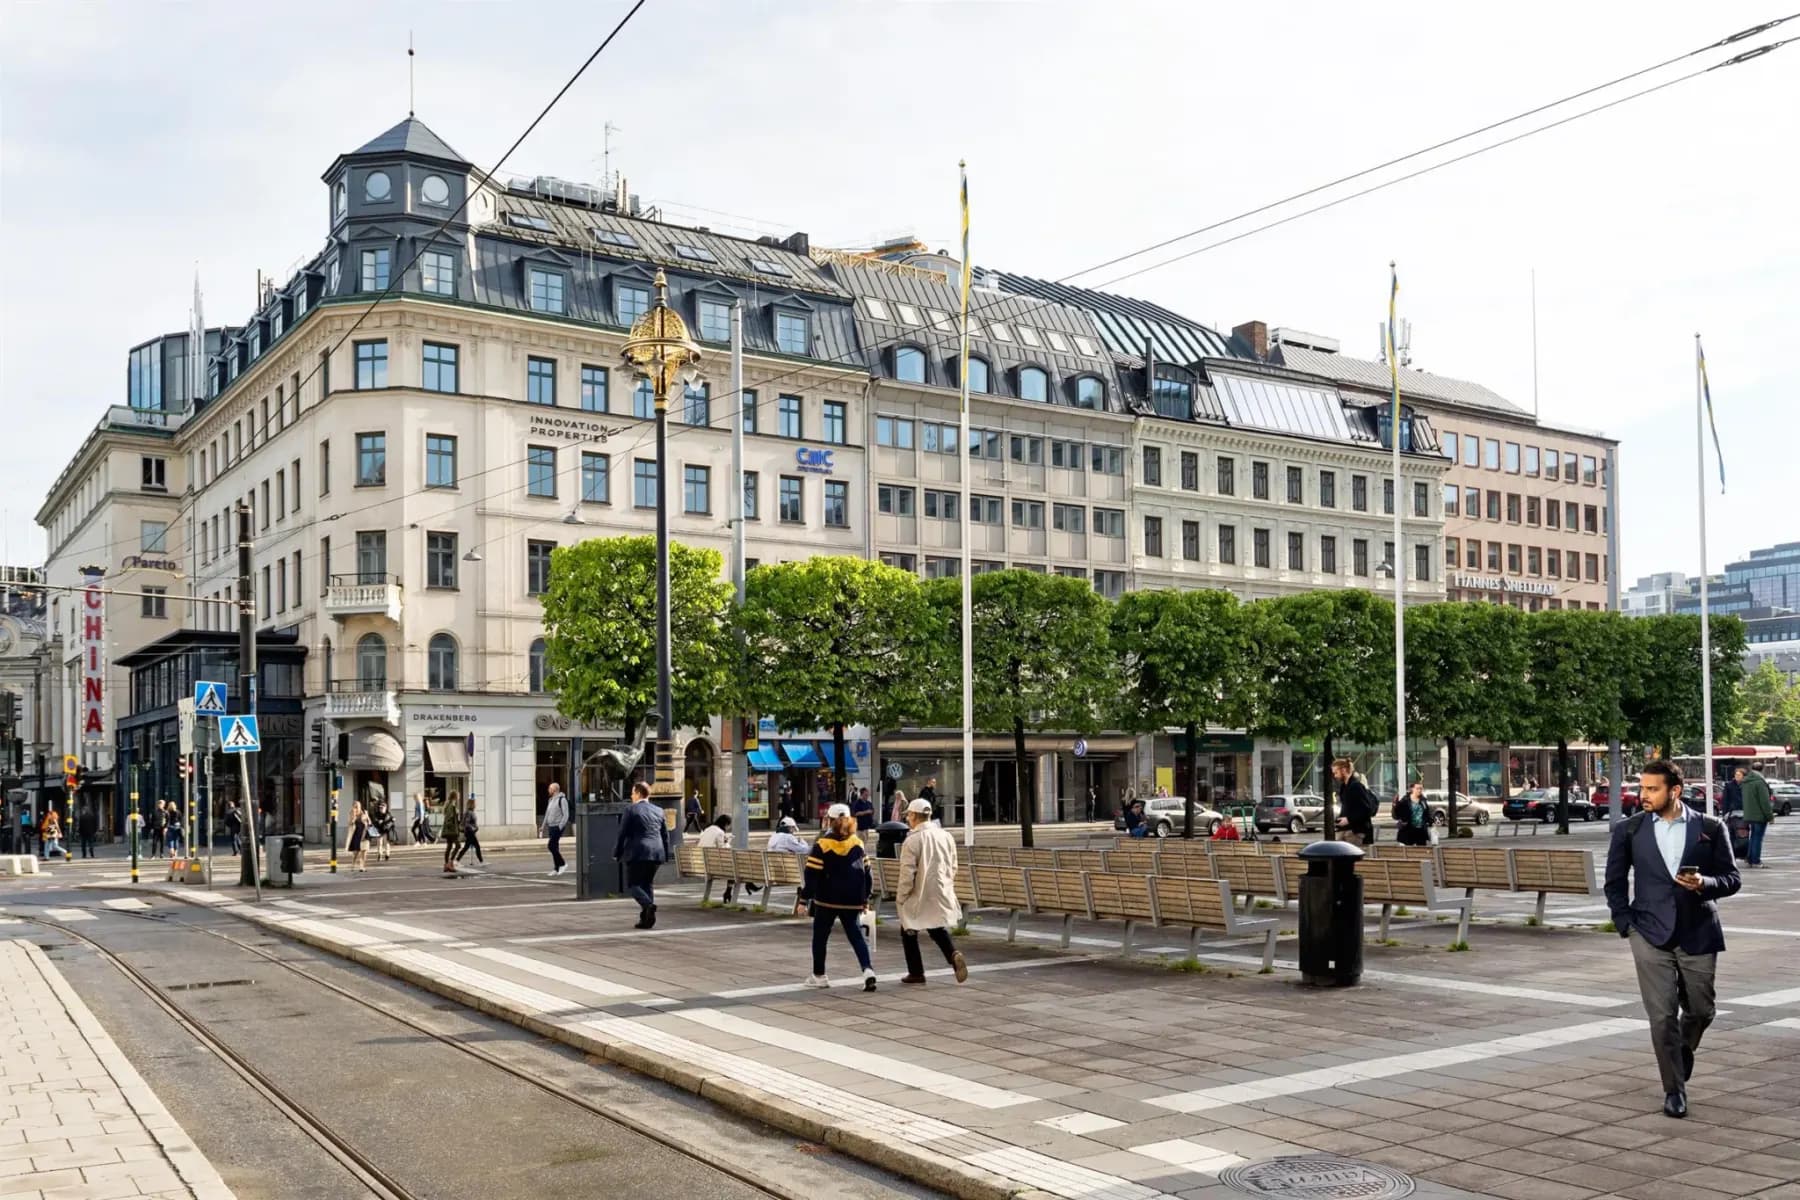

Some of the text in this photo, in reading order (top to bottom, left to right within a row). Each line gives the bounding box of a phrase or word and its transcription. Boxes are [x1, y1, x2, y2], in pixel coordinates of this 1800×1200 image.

[530, 416, 608, 432] INNOVATION
[530, 427, 608, 443] PROPERTIES
[1455, 571, 1502, 590] HANNES
[85, 584, 103, 733] CHINA
[413, 713, 478, 722] DRAKENBERG
